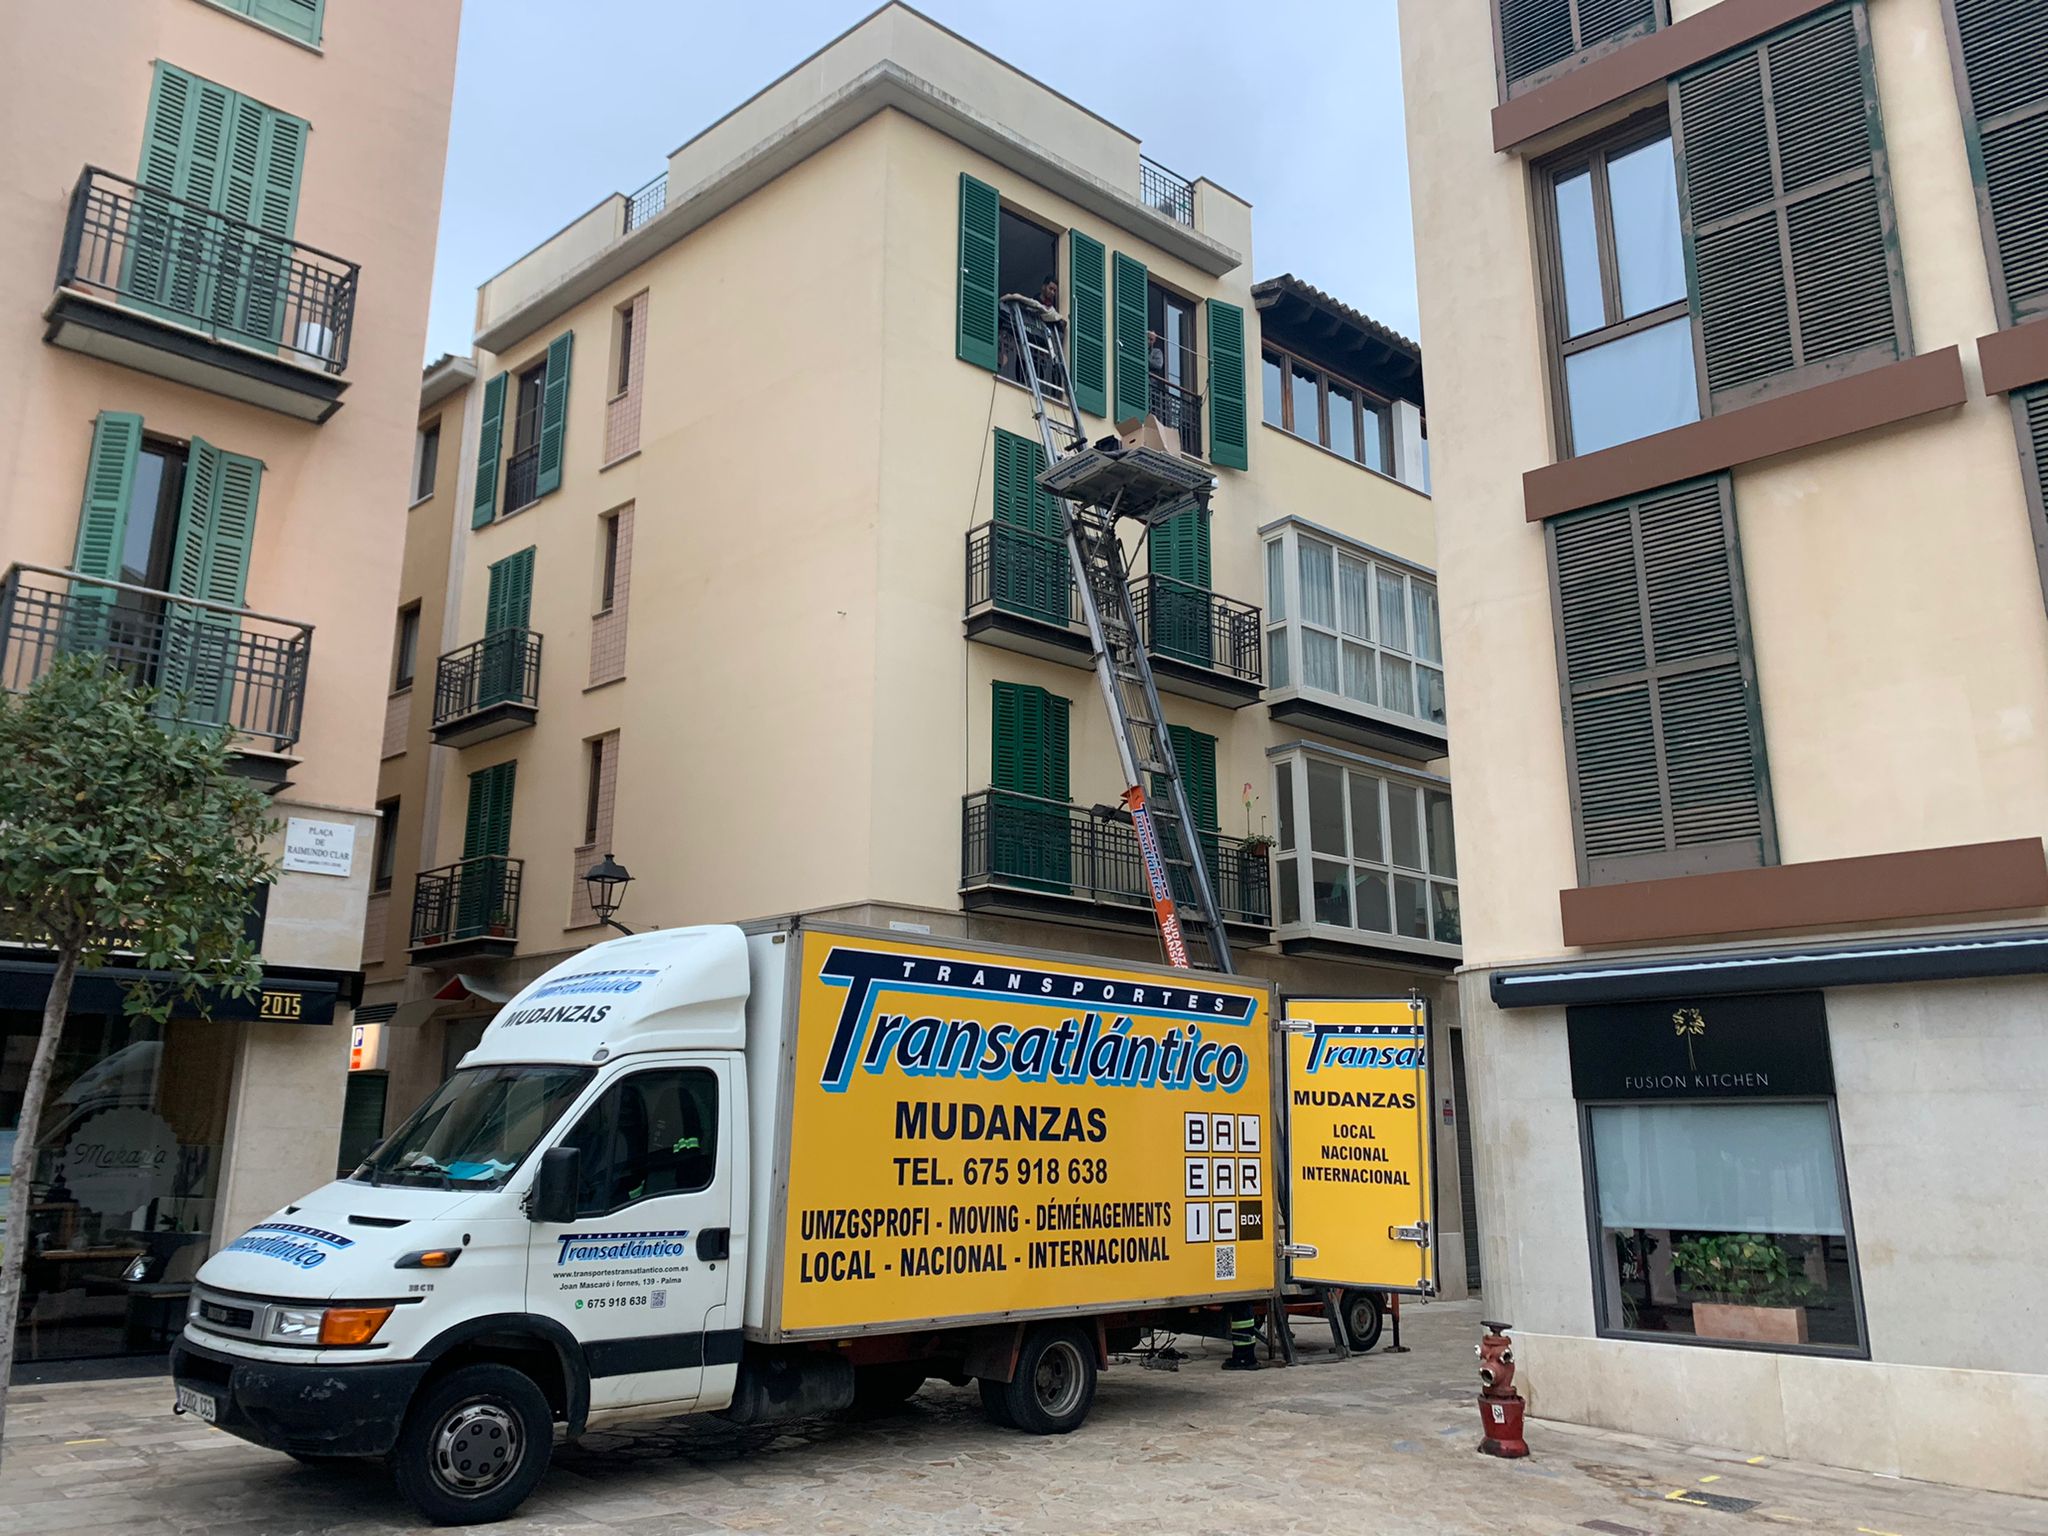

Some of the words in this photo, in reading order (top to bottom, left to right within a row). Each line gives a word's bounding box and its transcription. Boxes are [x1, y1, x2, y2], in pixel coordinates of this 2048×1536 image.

[308, 826, 334, 837] PLAÇA
[315, 838, 325, 847] DE
[287, 845, 329, 858] RAIMUNDO
[330, 850, 350, 861] CLAR
[902, 960, 1225, 1013] TRANSPORTES
[260, 995, 302, 1016] 2015
[501, 1005, 612, 1028] MUDANZAS
[819, 946, 1249, 1093] Transatlántico
[1337, 1025, 1417, 1035] TRANS
[1625, 1075, 1687, 1089] FUSION
[1695, 1073, 1769, 1089] KITCHEN
[1294, 1090, 1416, 1110] MUDANZAS
[894, 1101, 1108, 1144] MUDANZAS
[1333, 1124, 1376, 1140] LOCAL
[1321, 1145, 1389, 1162] NACIONAL
[893, 1158, 954, 1187] TEL.
[963, 1158, 1009, 1186] 675
[1017, 1159, 1060, 1185] 918
[1067, 1158, 1109, 1185] 638
[1302, 1166, 1410, 1186] INTERNACIONAL
[801, 1207, 930, 1240] UMZGSPROFI
[949, 1204, 1019, 1235] MOVING
[1036, 1196, 1172, 1231] DÉMÉNAGEMENTS
[1240, 1214, 1262, 1226] BOX
[558, 1233, 685, 1265] Transatlántico
[800, 1250, 876, 1283] LOCAL
[900, 1243, 1007, 1277] NACIONAL
[1028, 1236, 1170, 1269] INTERNACIONAL
[559, 1282, 578, 1290] Joan
[642, 1278, 655, 1286] 139
[660, 1276, 682, 1285] Palma
[587, 1298, 606, 1308] 675
[608, 1297, 627, 1307] 918
[629, 1295, 647, 1306] 638
